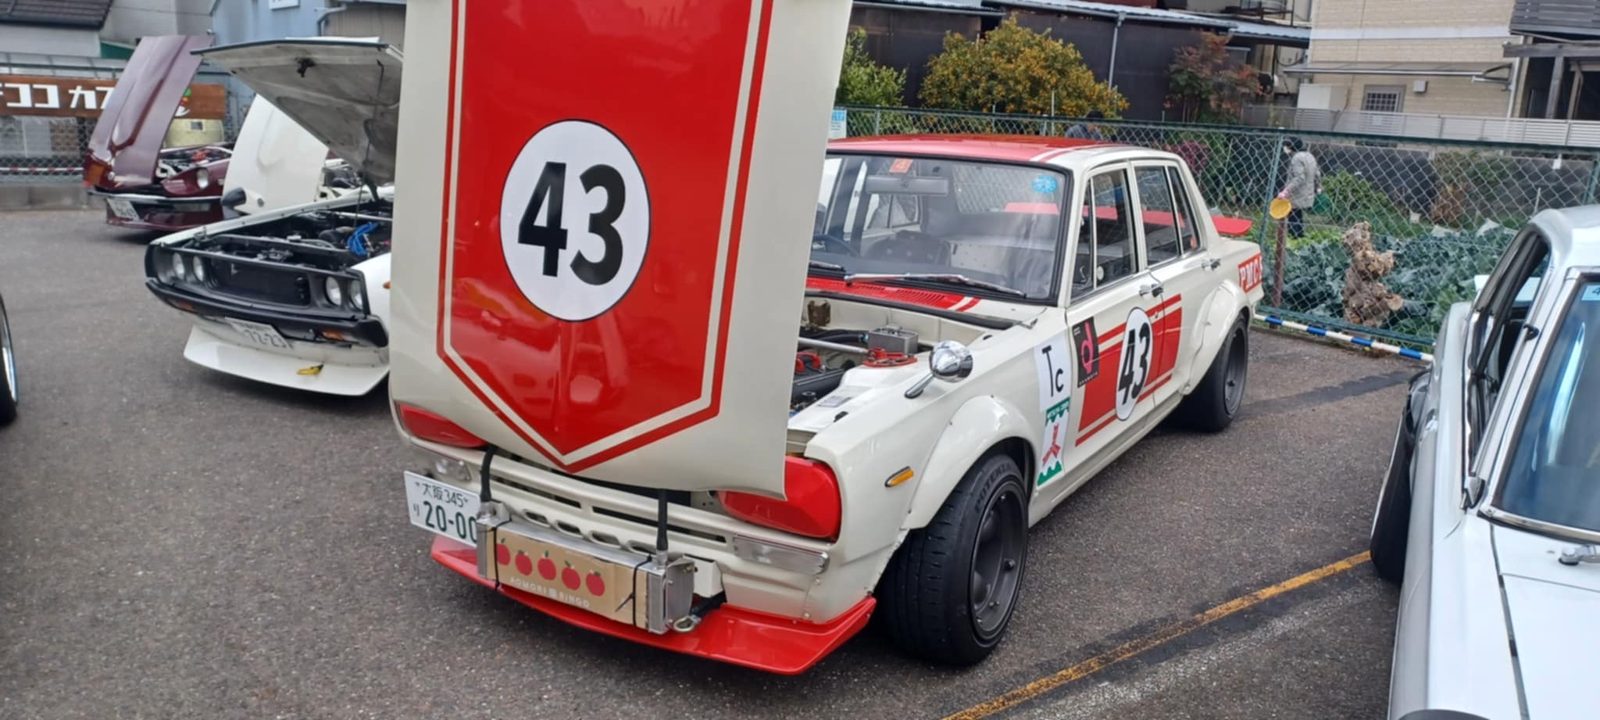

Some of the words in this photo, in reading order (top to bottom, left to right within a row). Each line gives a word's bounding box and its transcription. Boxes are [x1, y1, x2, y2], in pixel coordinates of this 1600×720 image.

[0, 83, 60, 108] ココ
[518, 161, 626, 285] 43
[1118, 322, 1150, 405] 43
[423, 500, 476, 543] 20-00
